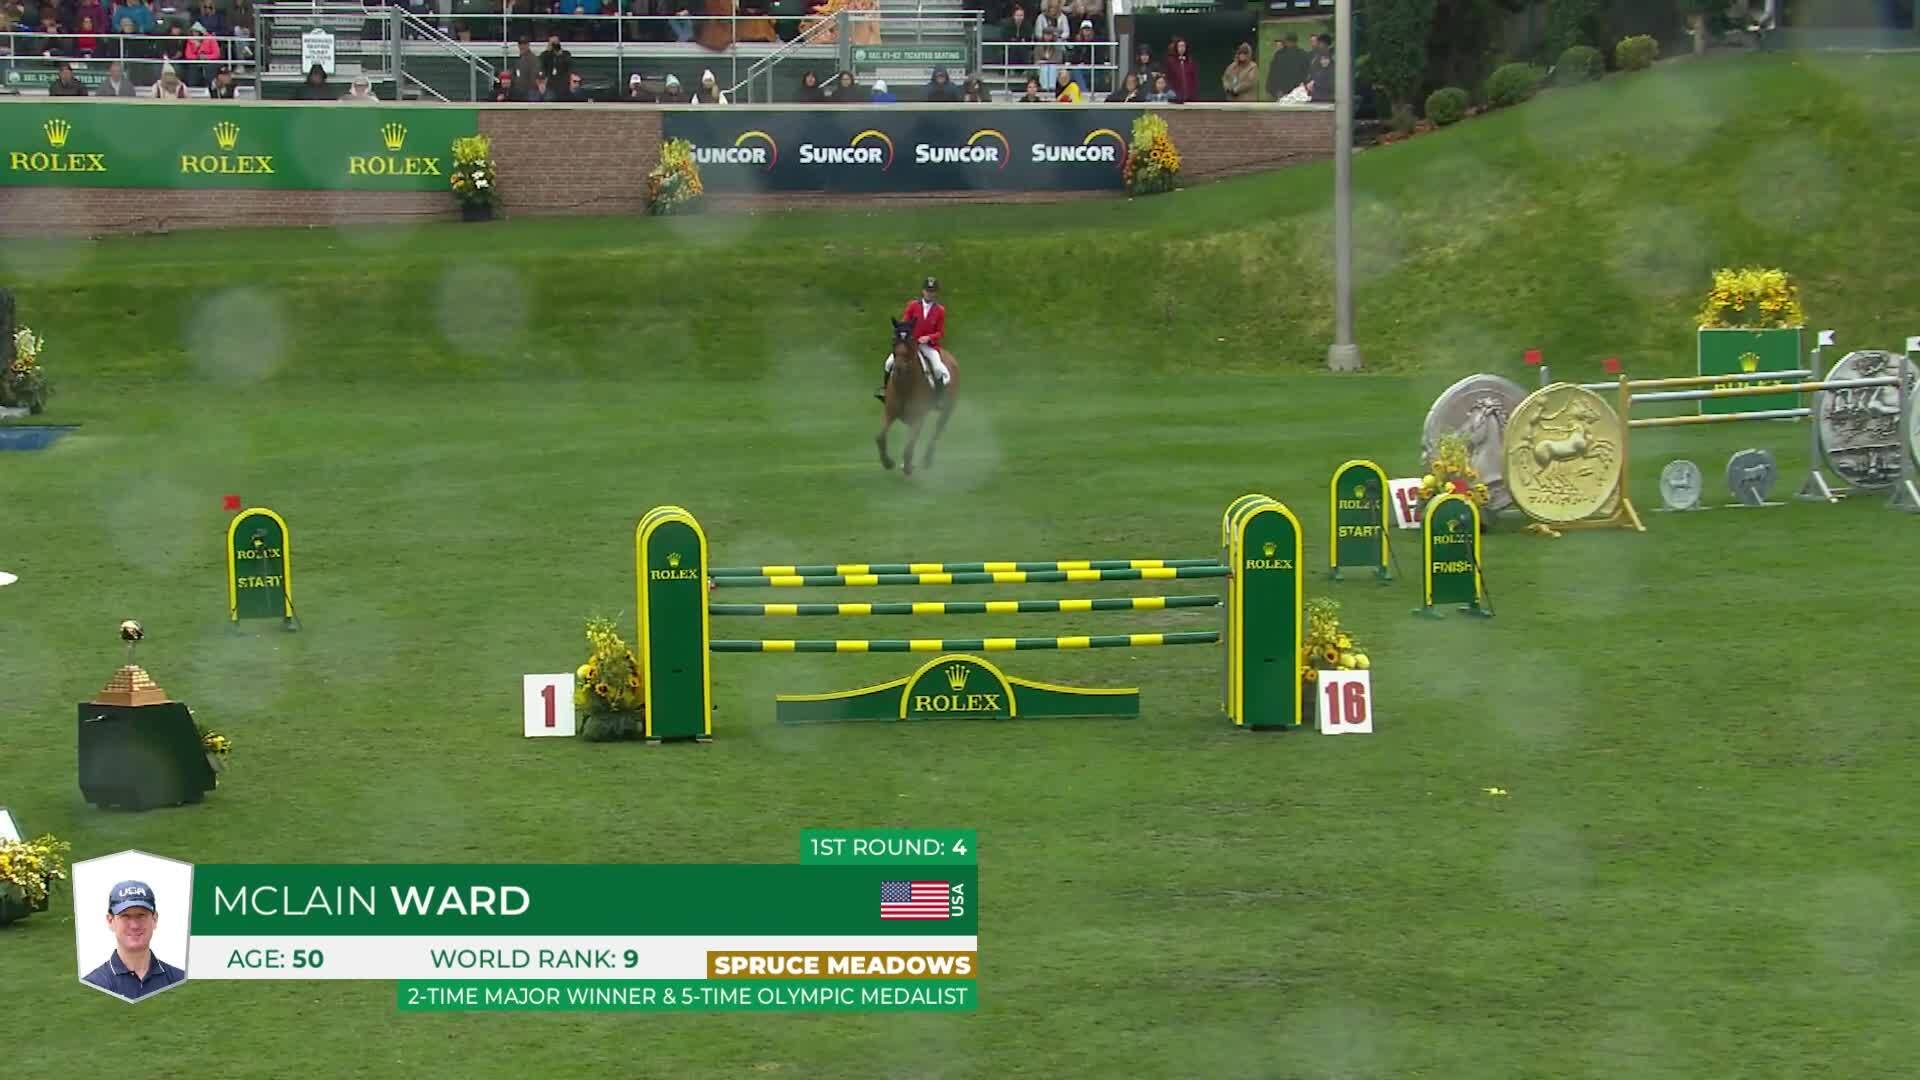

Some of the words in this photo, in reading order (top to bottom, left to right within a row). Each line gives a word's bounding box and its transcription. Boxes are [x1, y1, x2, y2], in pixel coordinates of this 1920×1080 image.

[9, 151, 107, 173] ROLEX
[799, 144, 882, 164] SUNCOR
[914, 144, 998, 164] SUNCOR
[1031, 143, 1115, 163] SUNCOR
[180, 155, 276, 174] ROLEX
[348, 156, 441, 176] ROLEX
[1338, 525, 1382, 538] START
[1245, 558, 1294, 570] ROLEX
[1432, 560, 1473, 574] FINISH
[237, 575, 283, 588] START
[650, 568, 698, 581] ROLEX
[539, 684, 556, 728] 1
[913, 693, 1001, 712] ROLEX
[1324, 681, 1367, 725] 16
